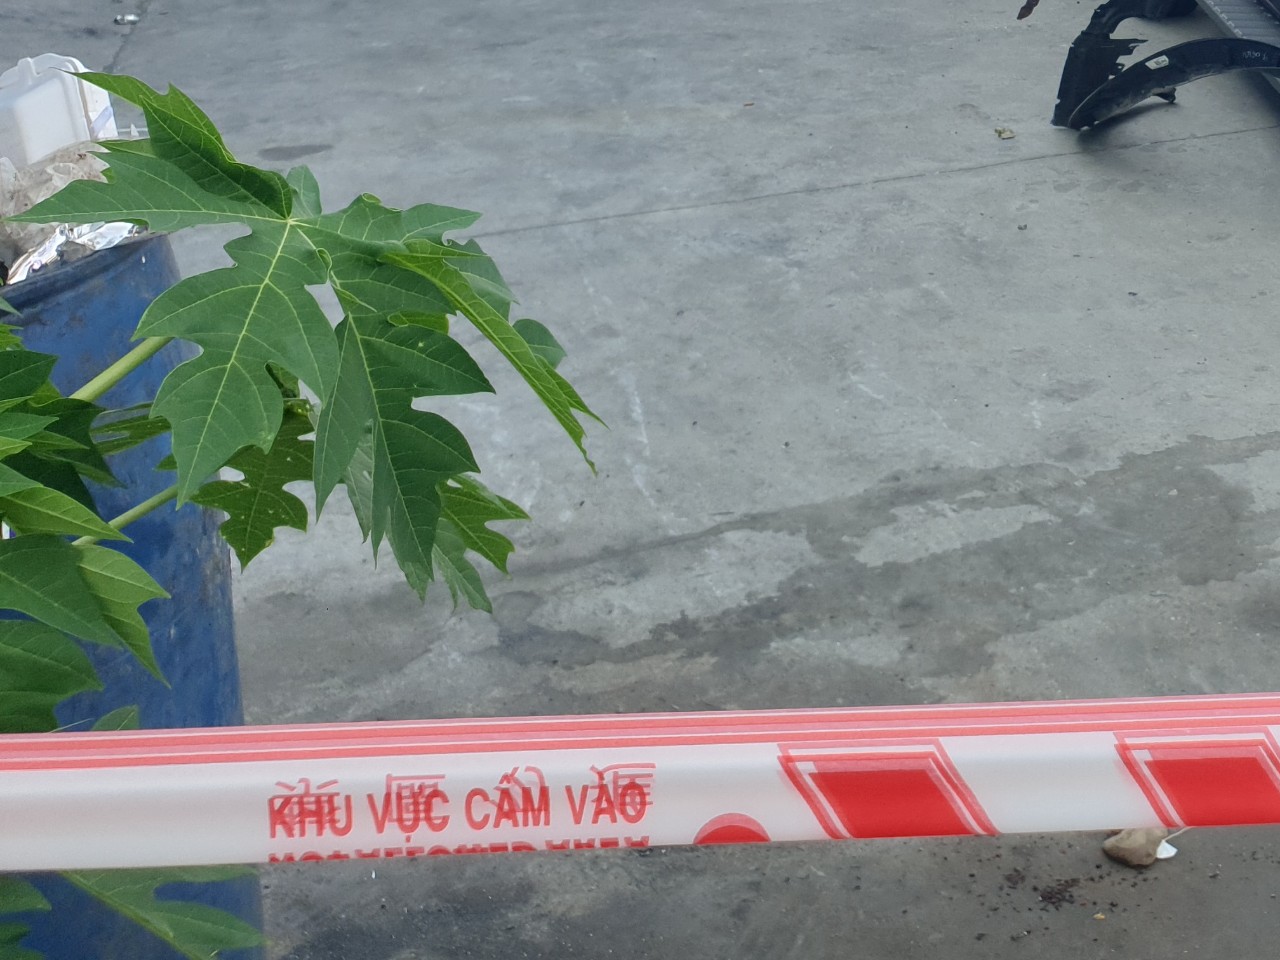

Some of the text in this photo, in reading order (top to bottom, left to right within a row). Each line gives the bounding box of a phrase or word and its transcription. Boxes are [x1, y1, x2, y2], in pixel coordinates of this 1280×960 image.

[268, 766, 648, 843] KHU VỰC CẤM VÀO
